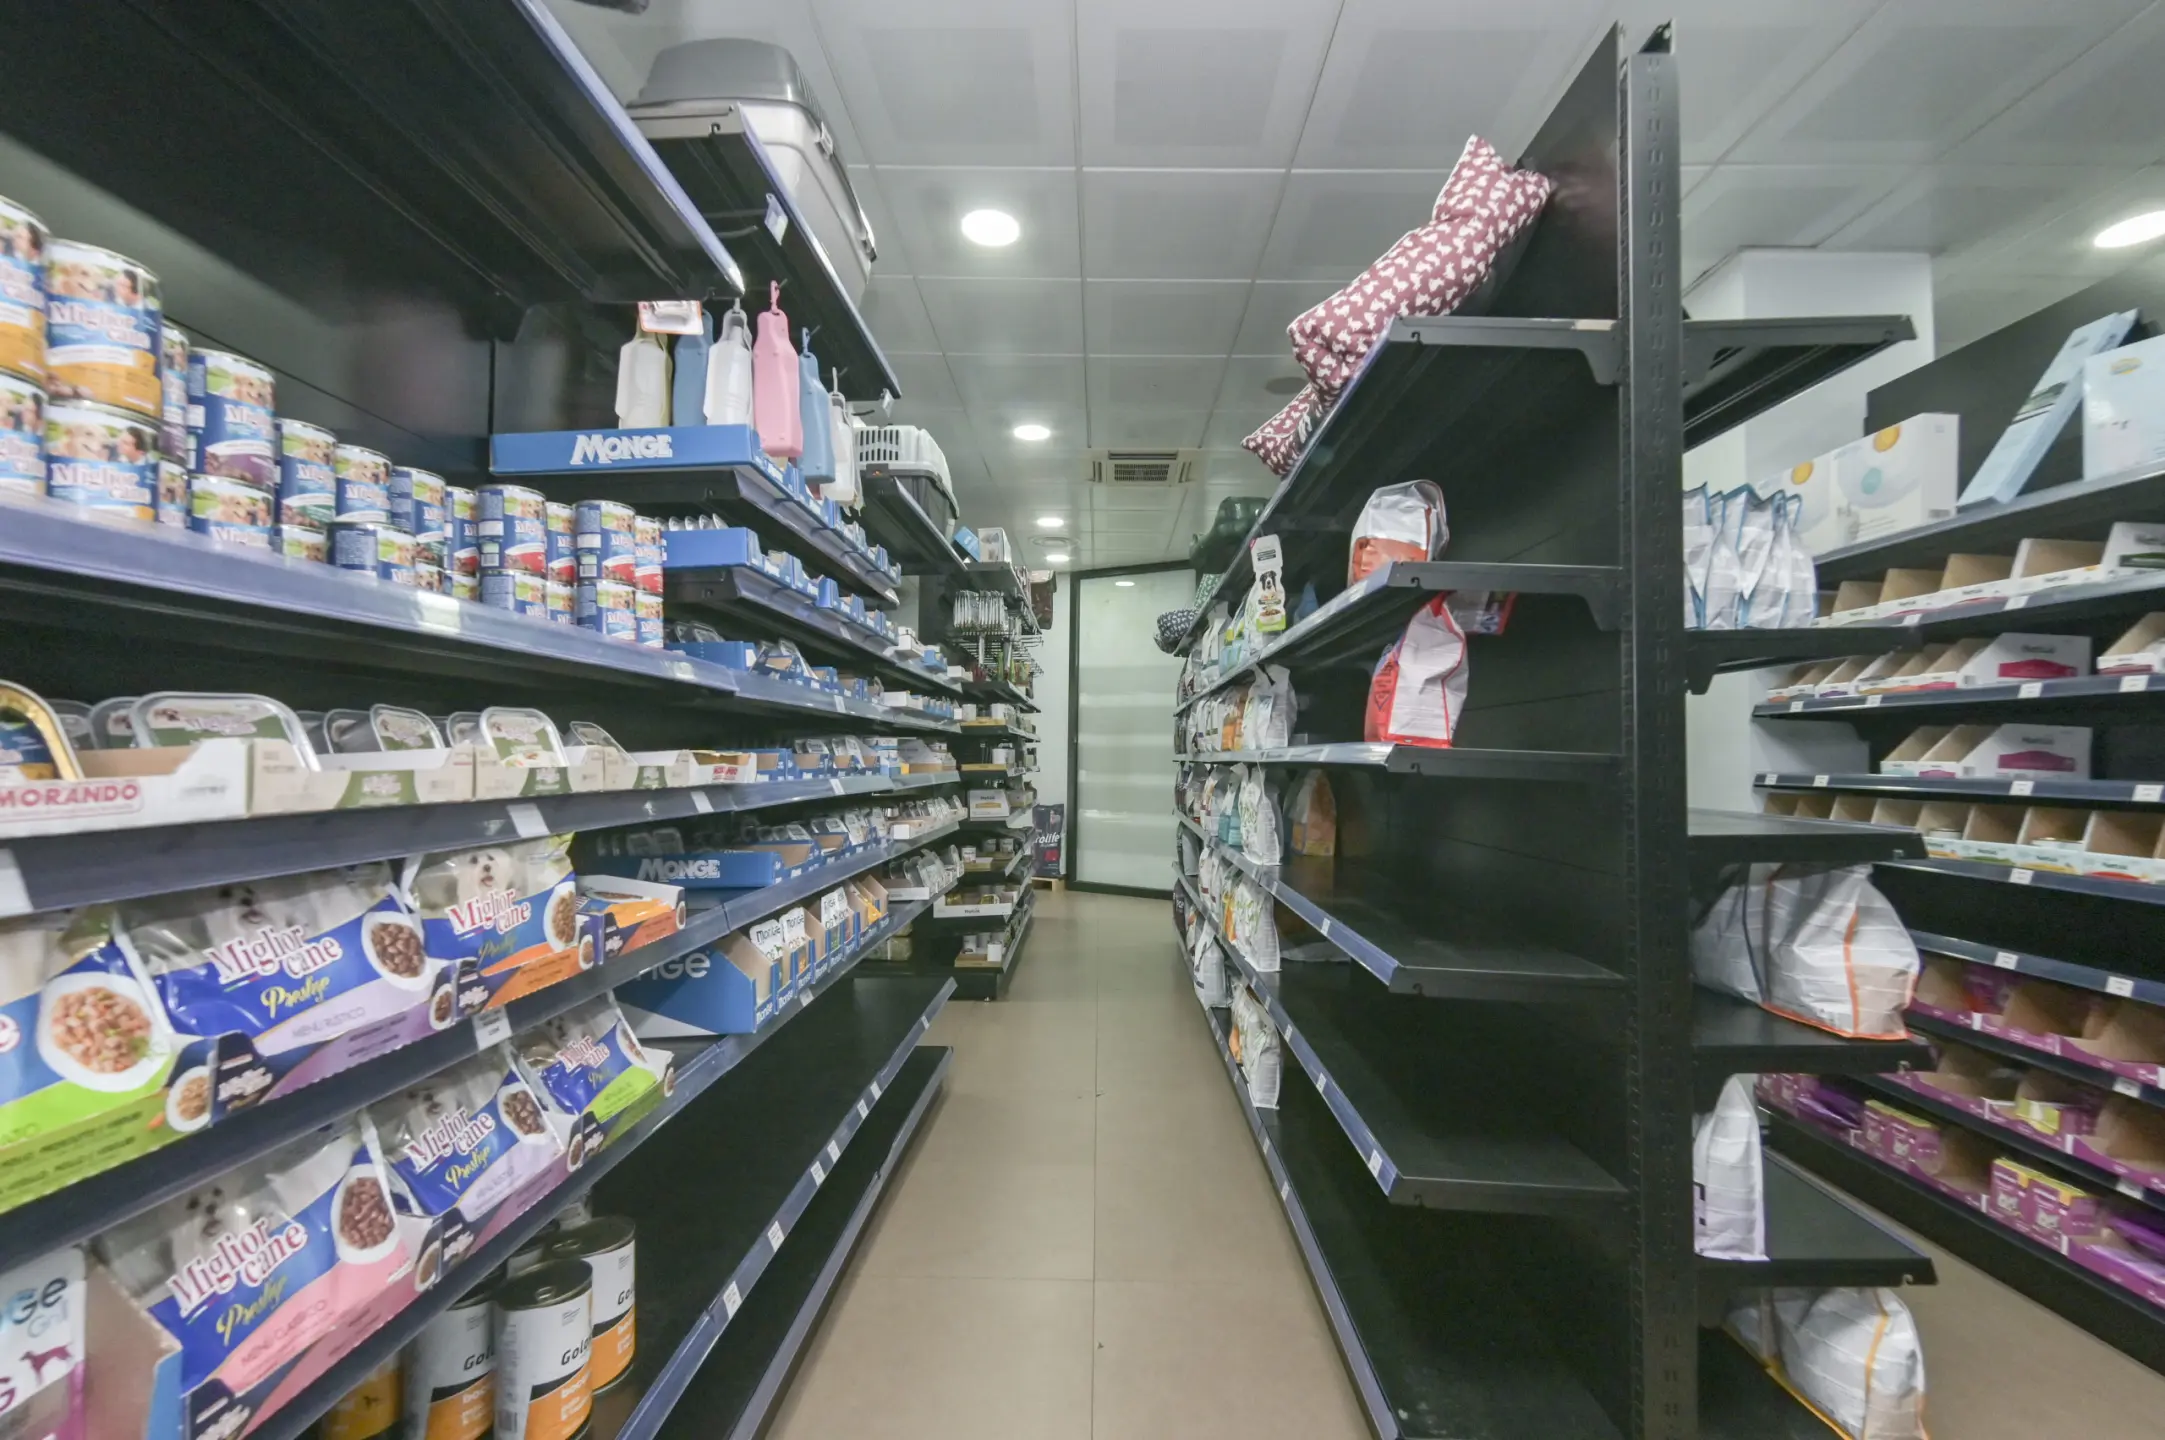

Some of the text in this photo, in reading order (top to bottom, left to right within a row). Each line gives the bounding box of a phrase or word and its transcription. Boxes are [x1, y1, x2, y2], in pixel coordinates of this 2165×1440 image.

[569, 434, 673, 465] MONGE
[636, 858, 721, 882] MONGE
[445, 888, 518, 935] Miglior
[203, 925, 305, 984] Miglior
[404, 1107, 470, 1174] Miglior
[166, 1217, 270, 1318] Miglior
